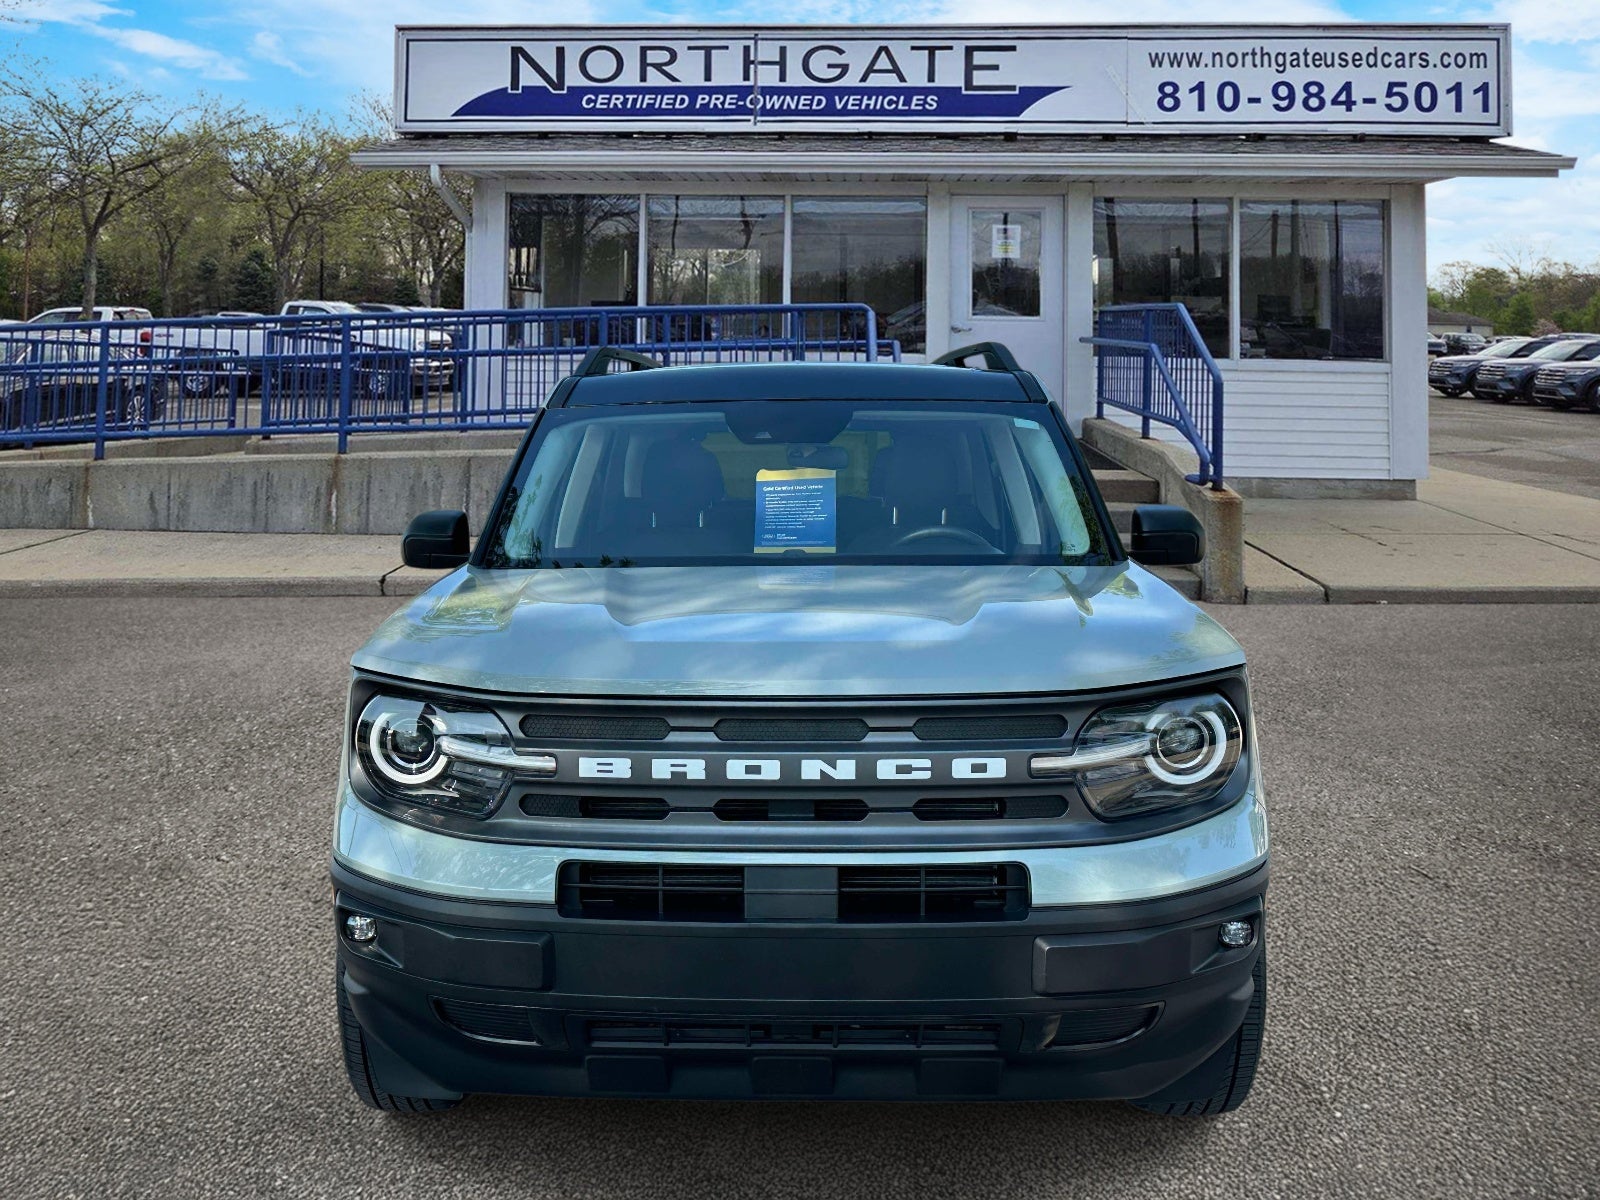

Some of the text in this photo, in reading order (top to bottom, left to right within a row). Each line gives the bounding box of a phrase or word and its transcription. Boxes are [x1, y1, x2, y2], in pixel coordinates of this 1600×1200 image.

[509, 44, 1018, 93] NORTHGATE
[1148, 46, 1488, 73] www.northgateusedcars.com
[581, 94, 939, 111] CERTIFIED PRE-OWNED VEHICLES
[1156, 80, 1491, 113] 810-984-5011
[578, 756, 1008, 780] BRONCO
